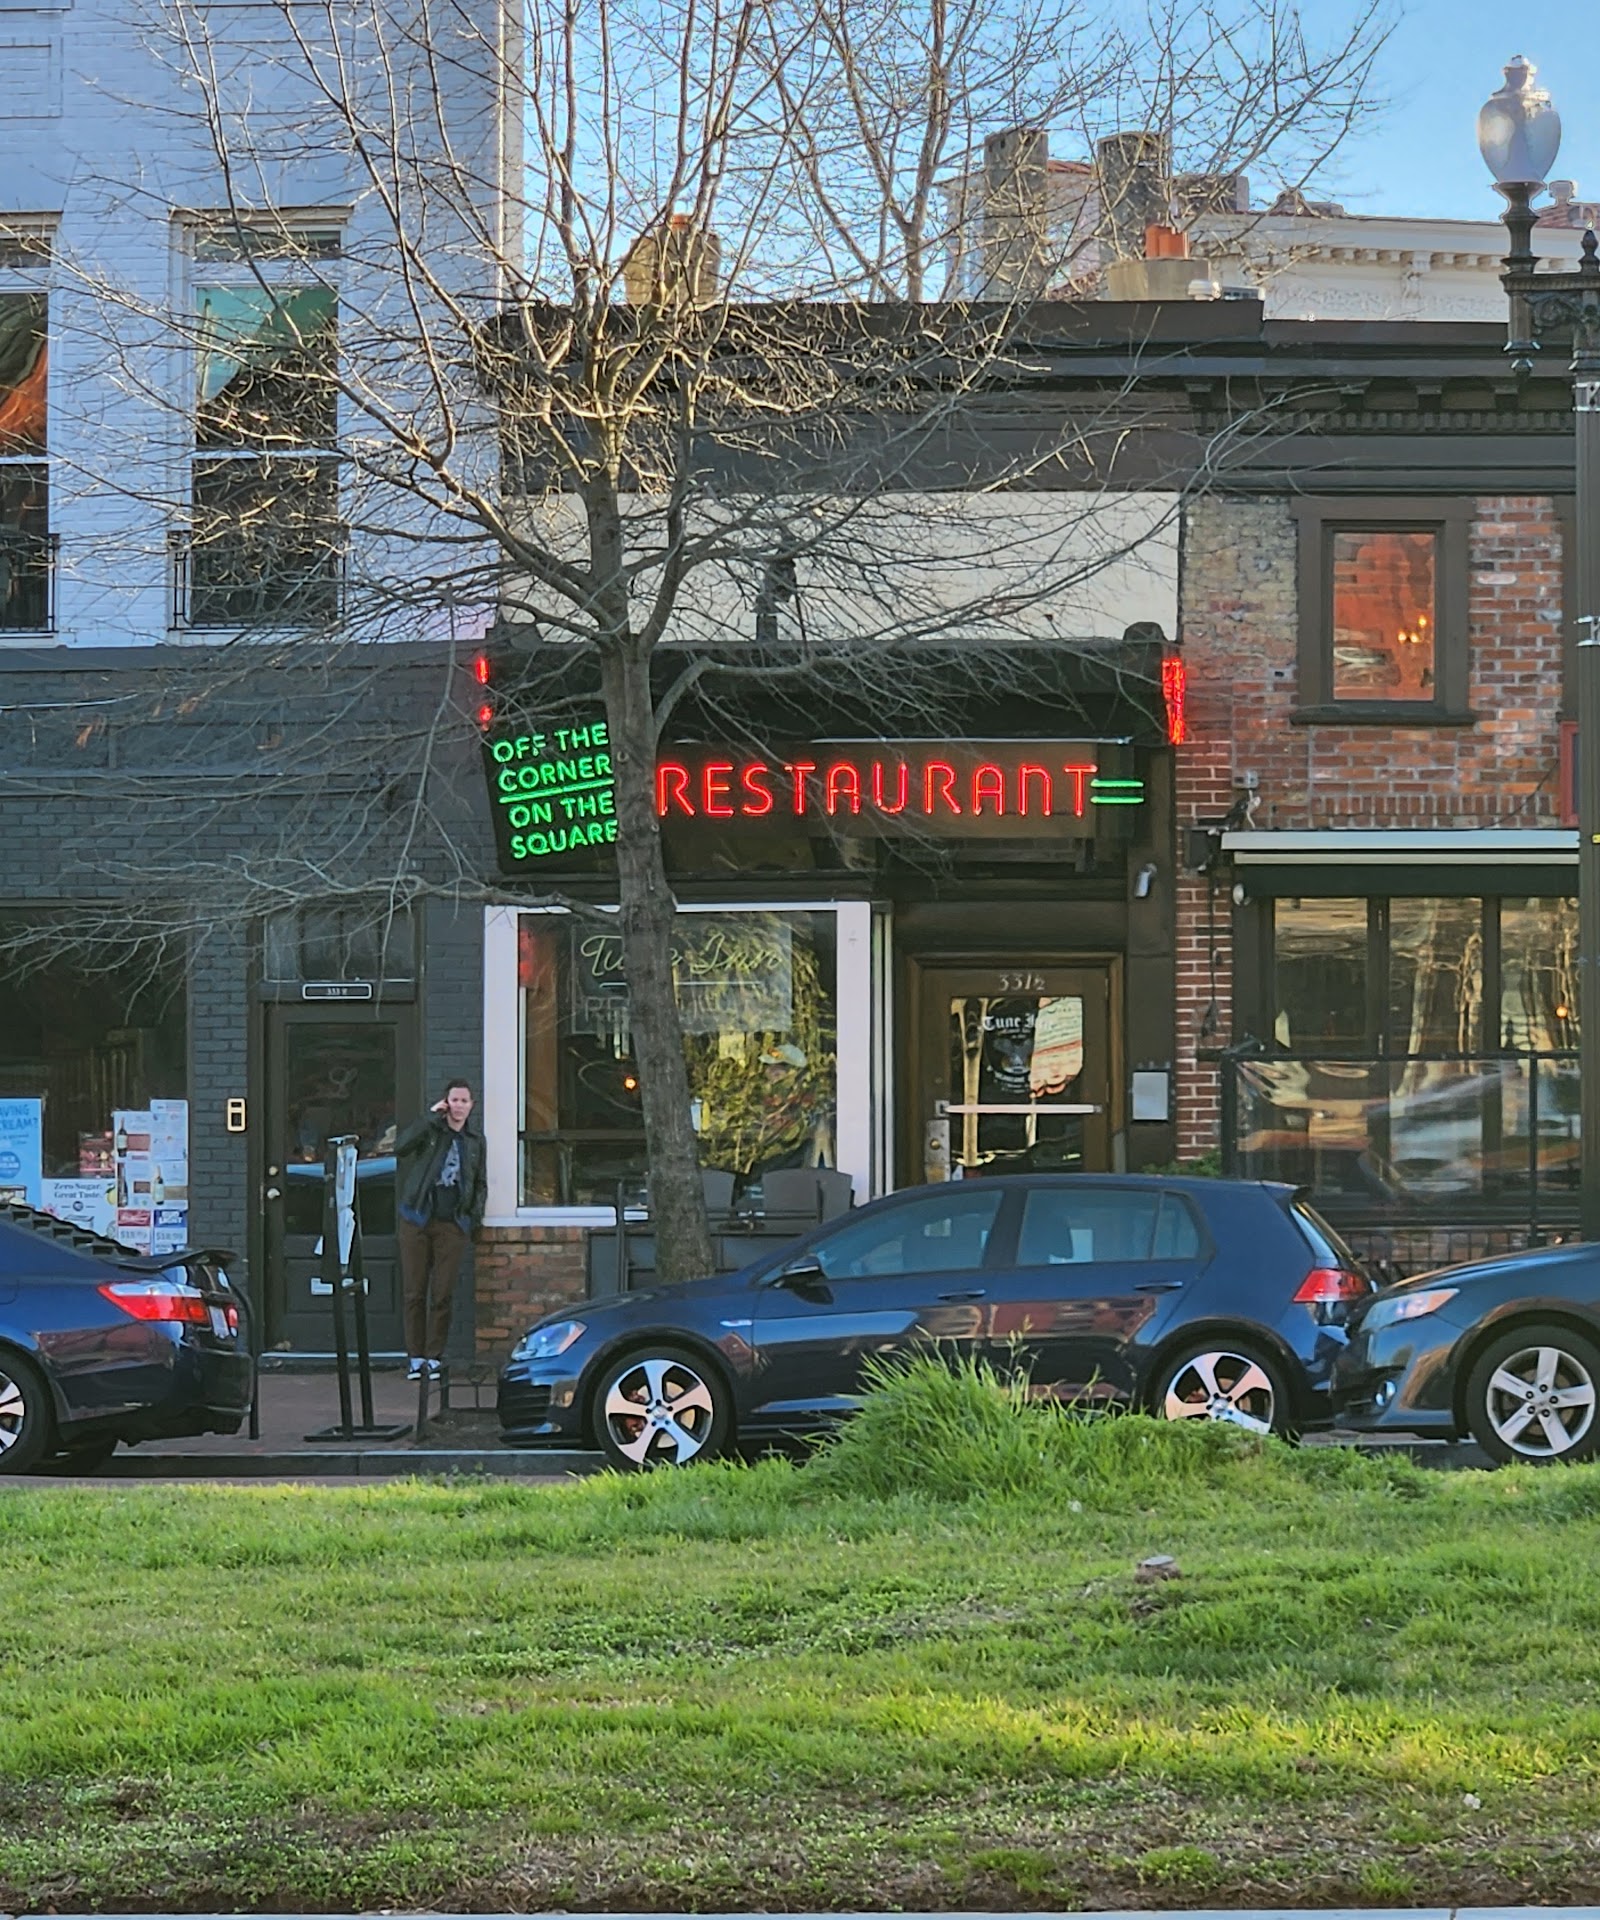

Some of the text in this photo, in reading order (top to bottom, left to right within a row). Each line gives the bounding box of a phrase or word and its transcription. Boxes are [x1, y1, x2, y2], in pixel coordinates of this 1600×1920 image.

[493, 722, 609, 763] OFF THE
[498, 754, 613, 792] CORNER
[655, 760, 1097, 819] RESTAURANT
[508, 790, 615, 829] ON THE
[510, 819, 619, 860] SQUARE
[580, 935, 684, 977] Tue
[982, 1015, 1022, 1031] Tune
